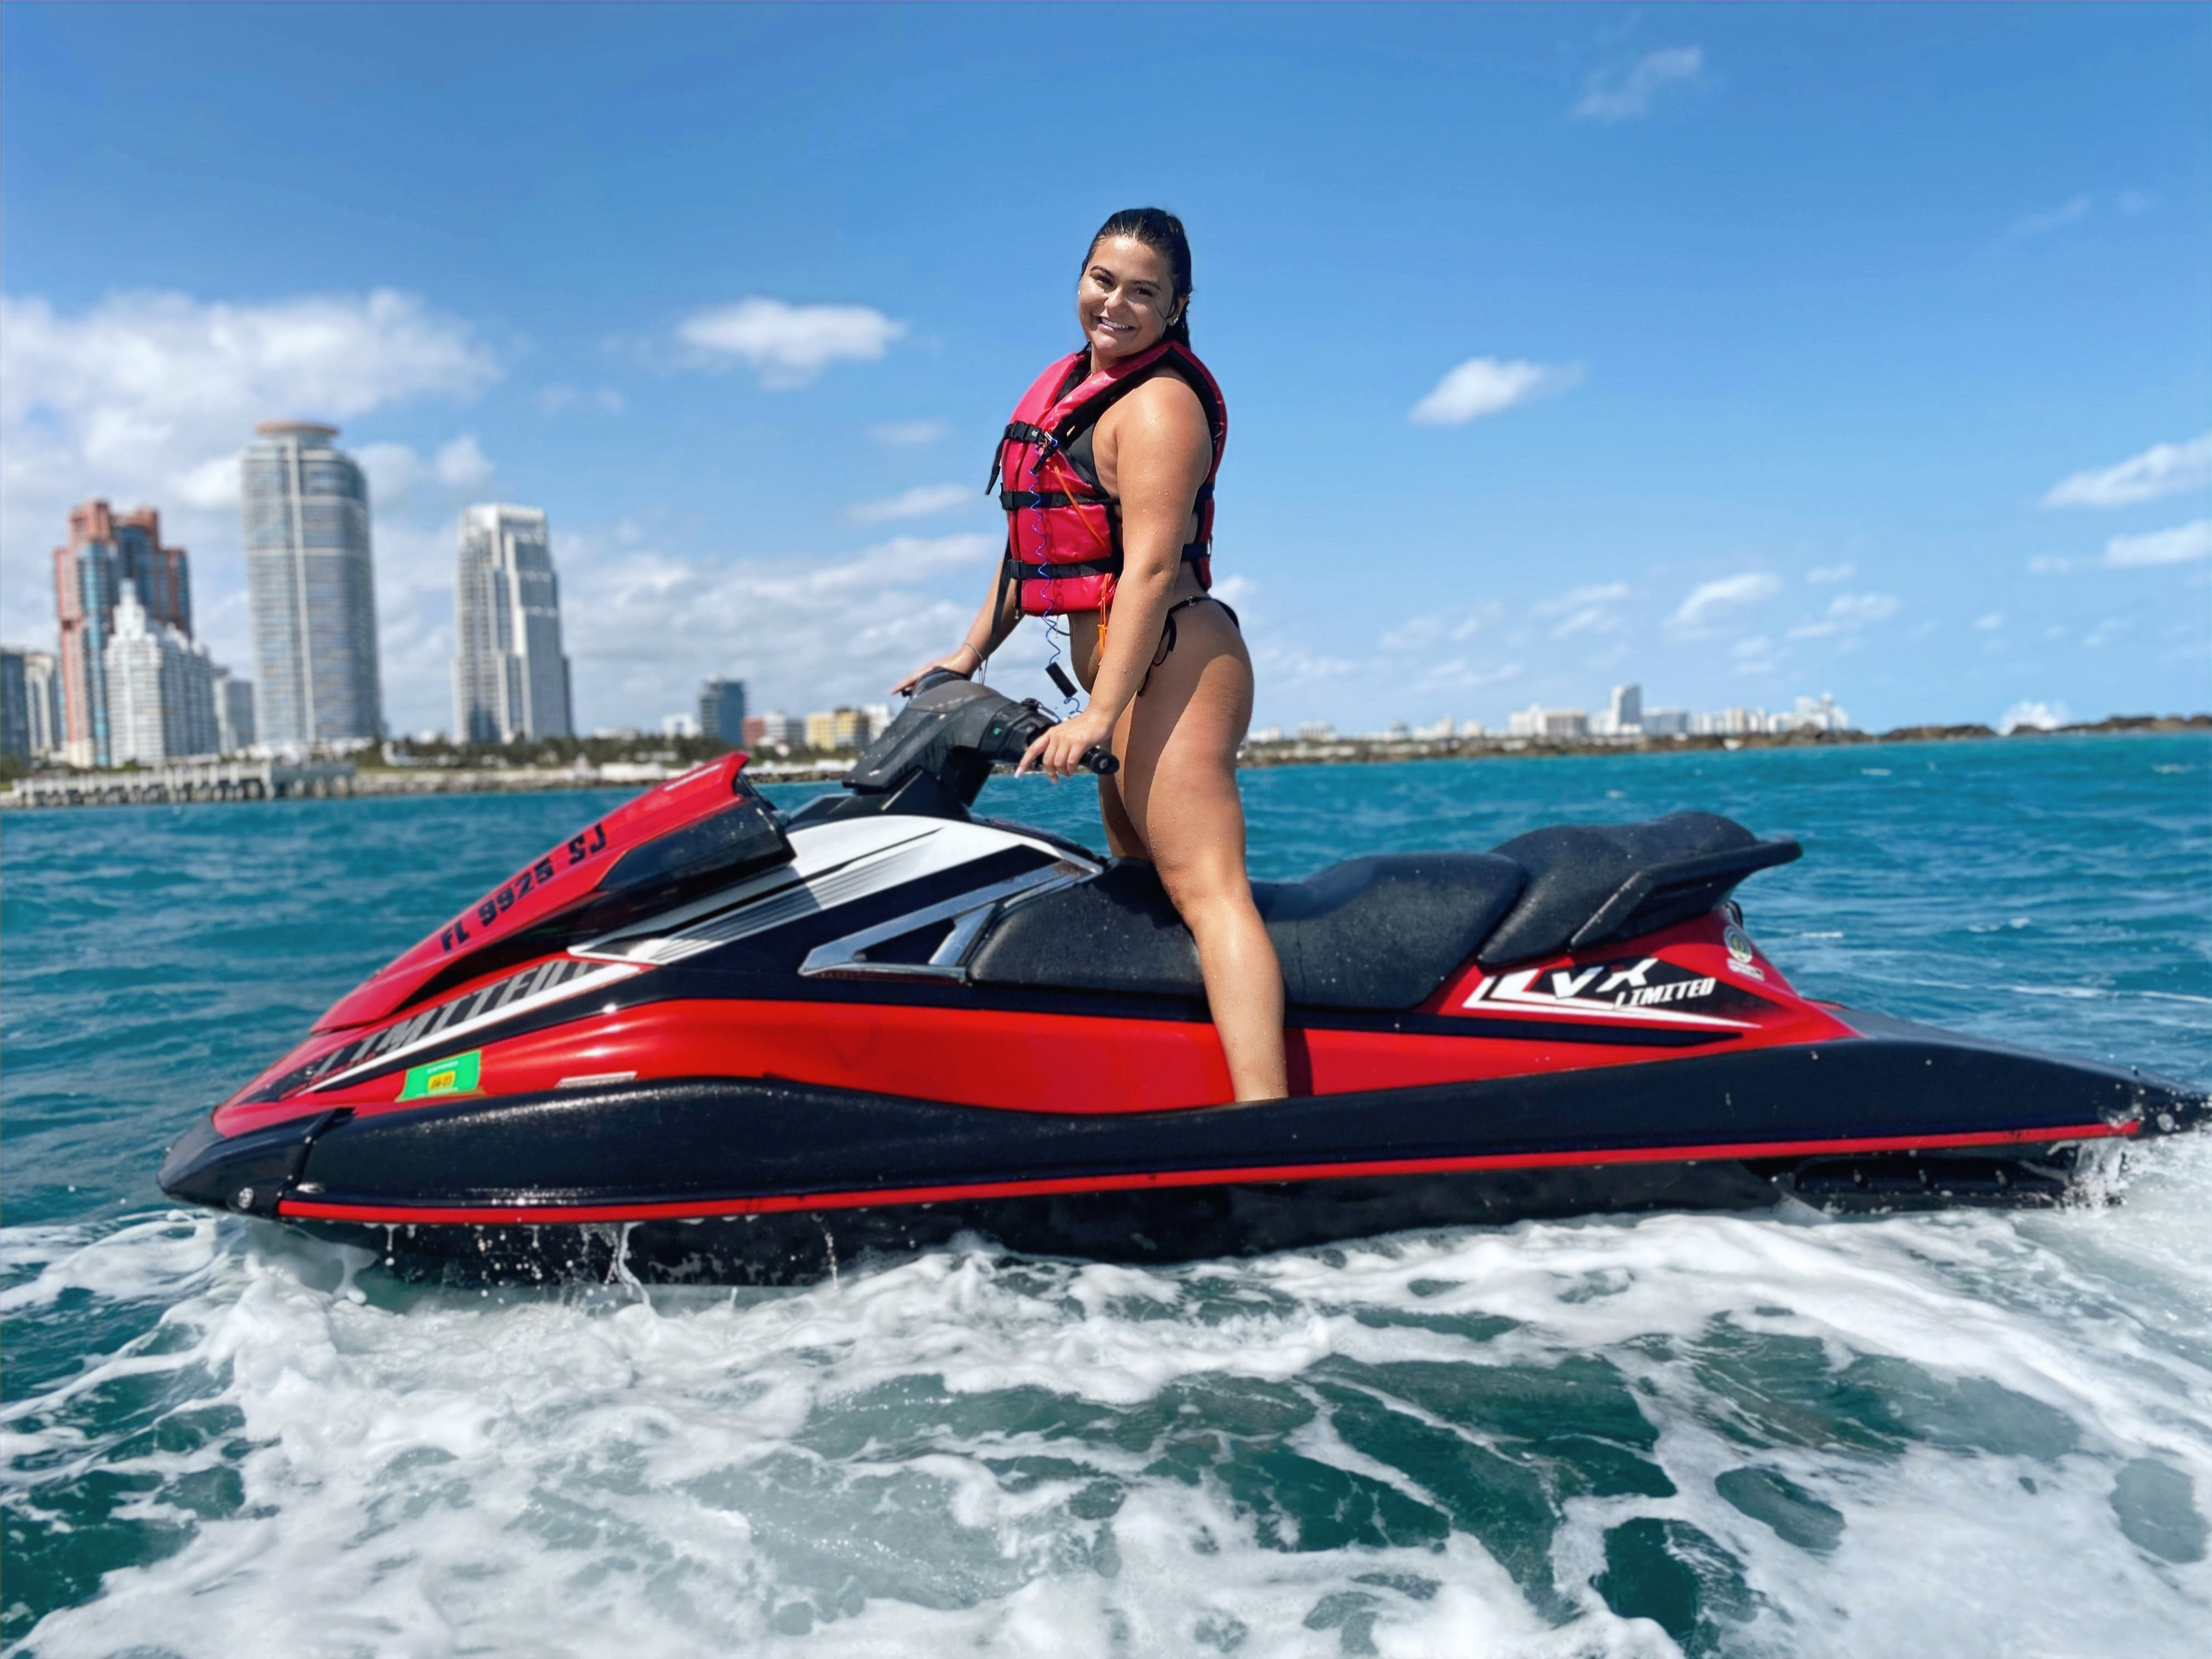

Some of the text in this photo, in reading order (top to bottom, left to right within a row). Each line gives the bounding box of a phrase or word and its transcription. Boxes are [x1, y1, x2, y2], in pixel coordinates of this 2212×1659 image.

[440, 824, 606, 952] FL 9925 SJ
[1551, 958, 1658, 998] VX
[1614, 977, 1717, 1010] LIMITED
